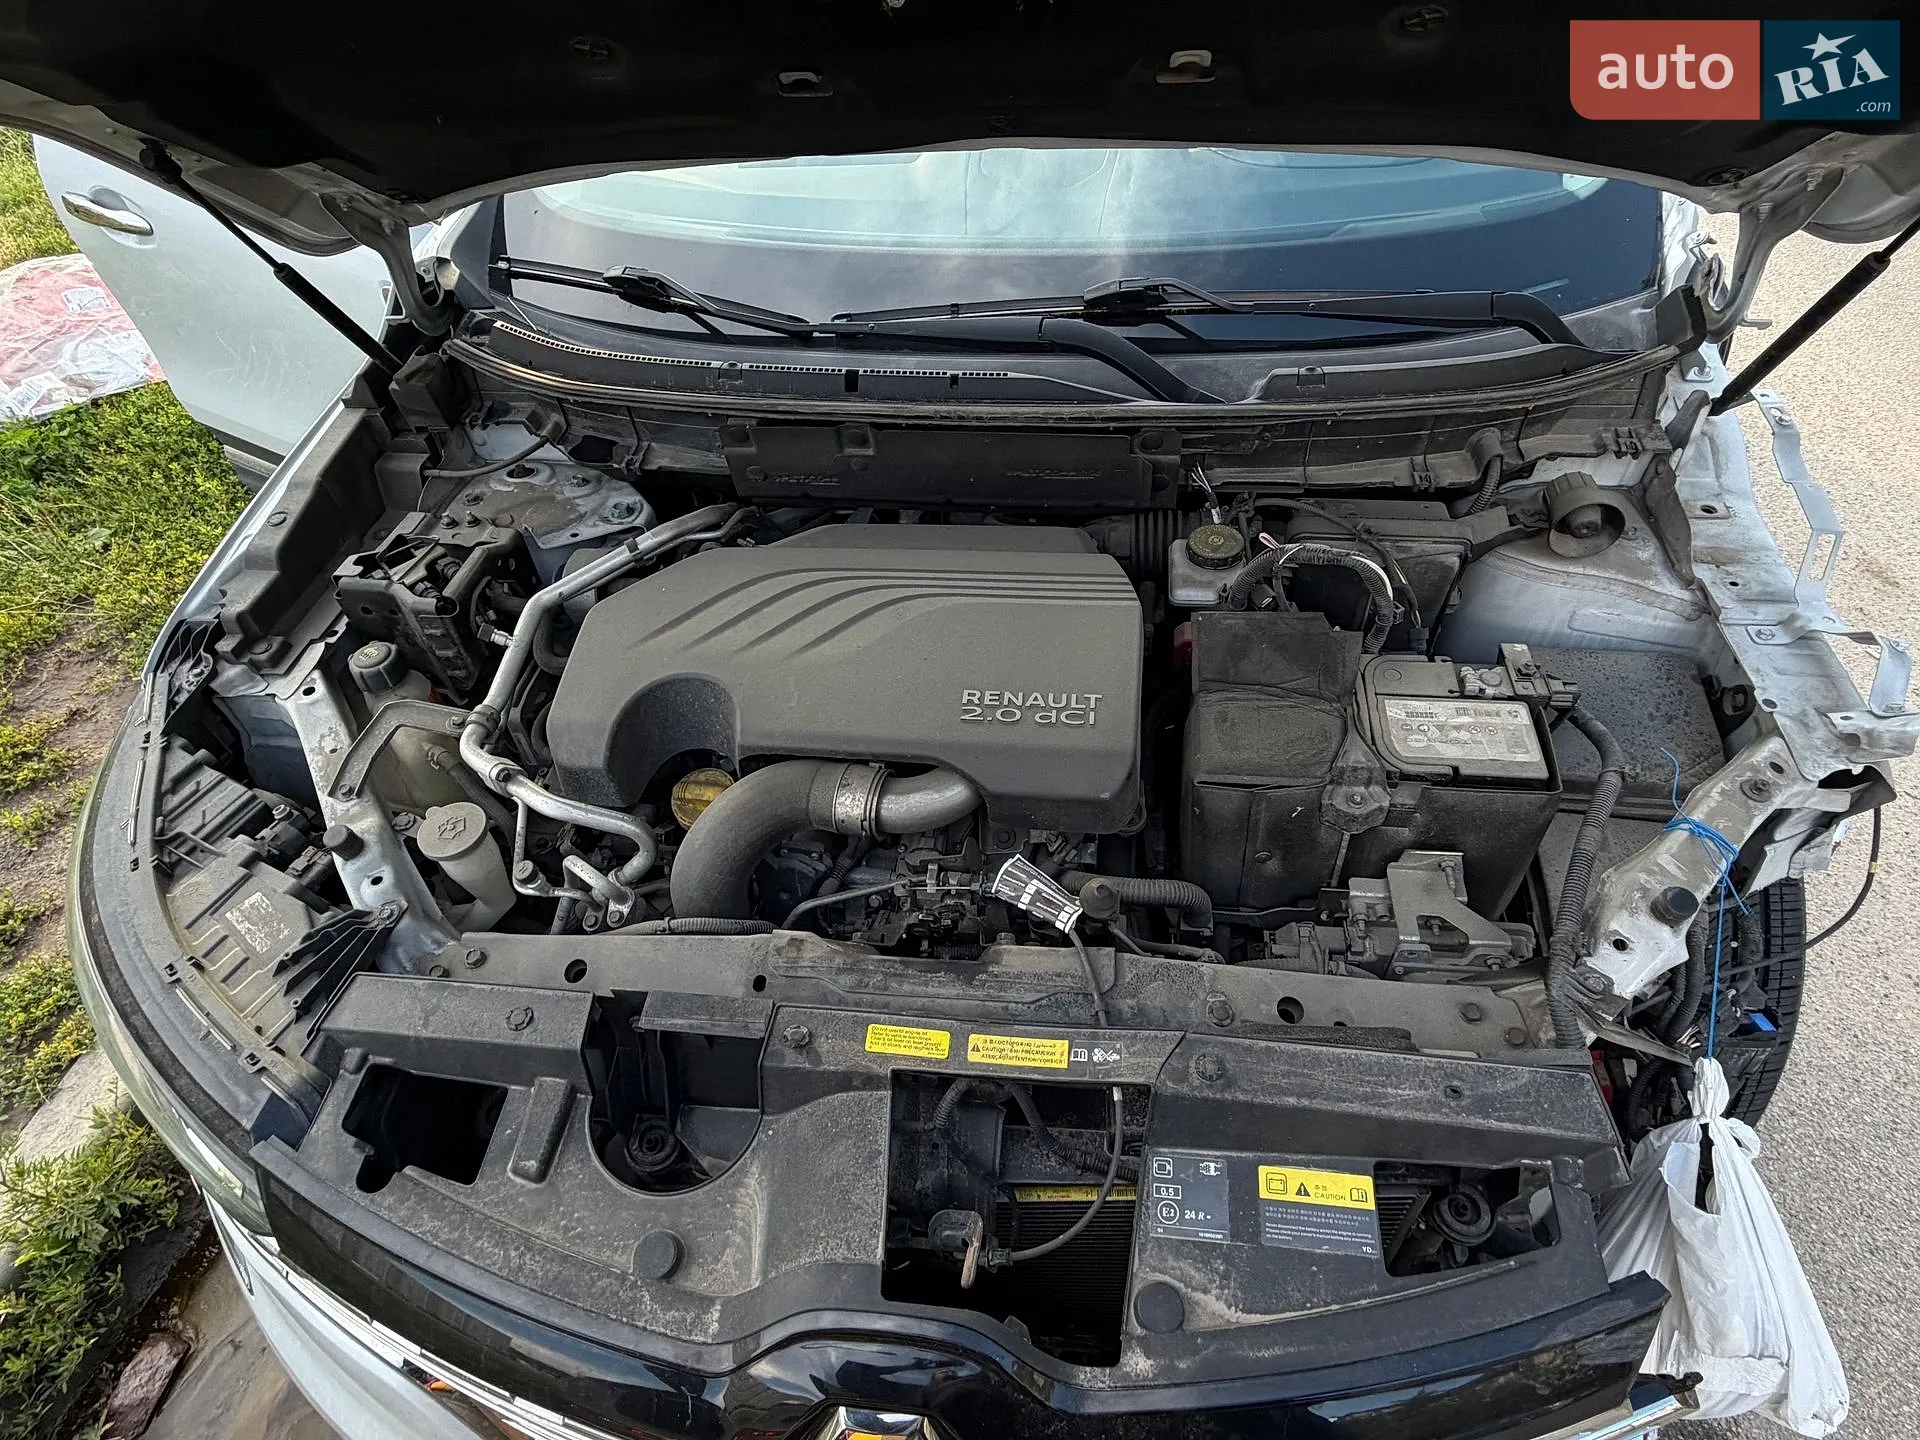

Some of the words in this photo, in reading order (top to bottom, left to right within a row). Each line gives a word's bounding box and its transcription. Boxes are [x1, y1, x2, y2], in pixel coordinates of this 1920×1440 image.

[961, 689, 1103, 709] RENAULT
[959, 706, 1022, 722] 2.0
[1160, 1187, 1174, 1196] 0.5
[1315, 1192, 1345, 1201] CAUTION
[1162, 1206, 1175, 1217] E2
[1185, 1210, 1195, 1219] 24
